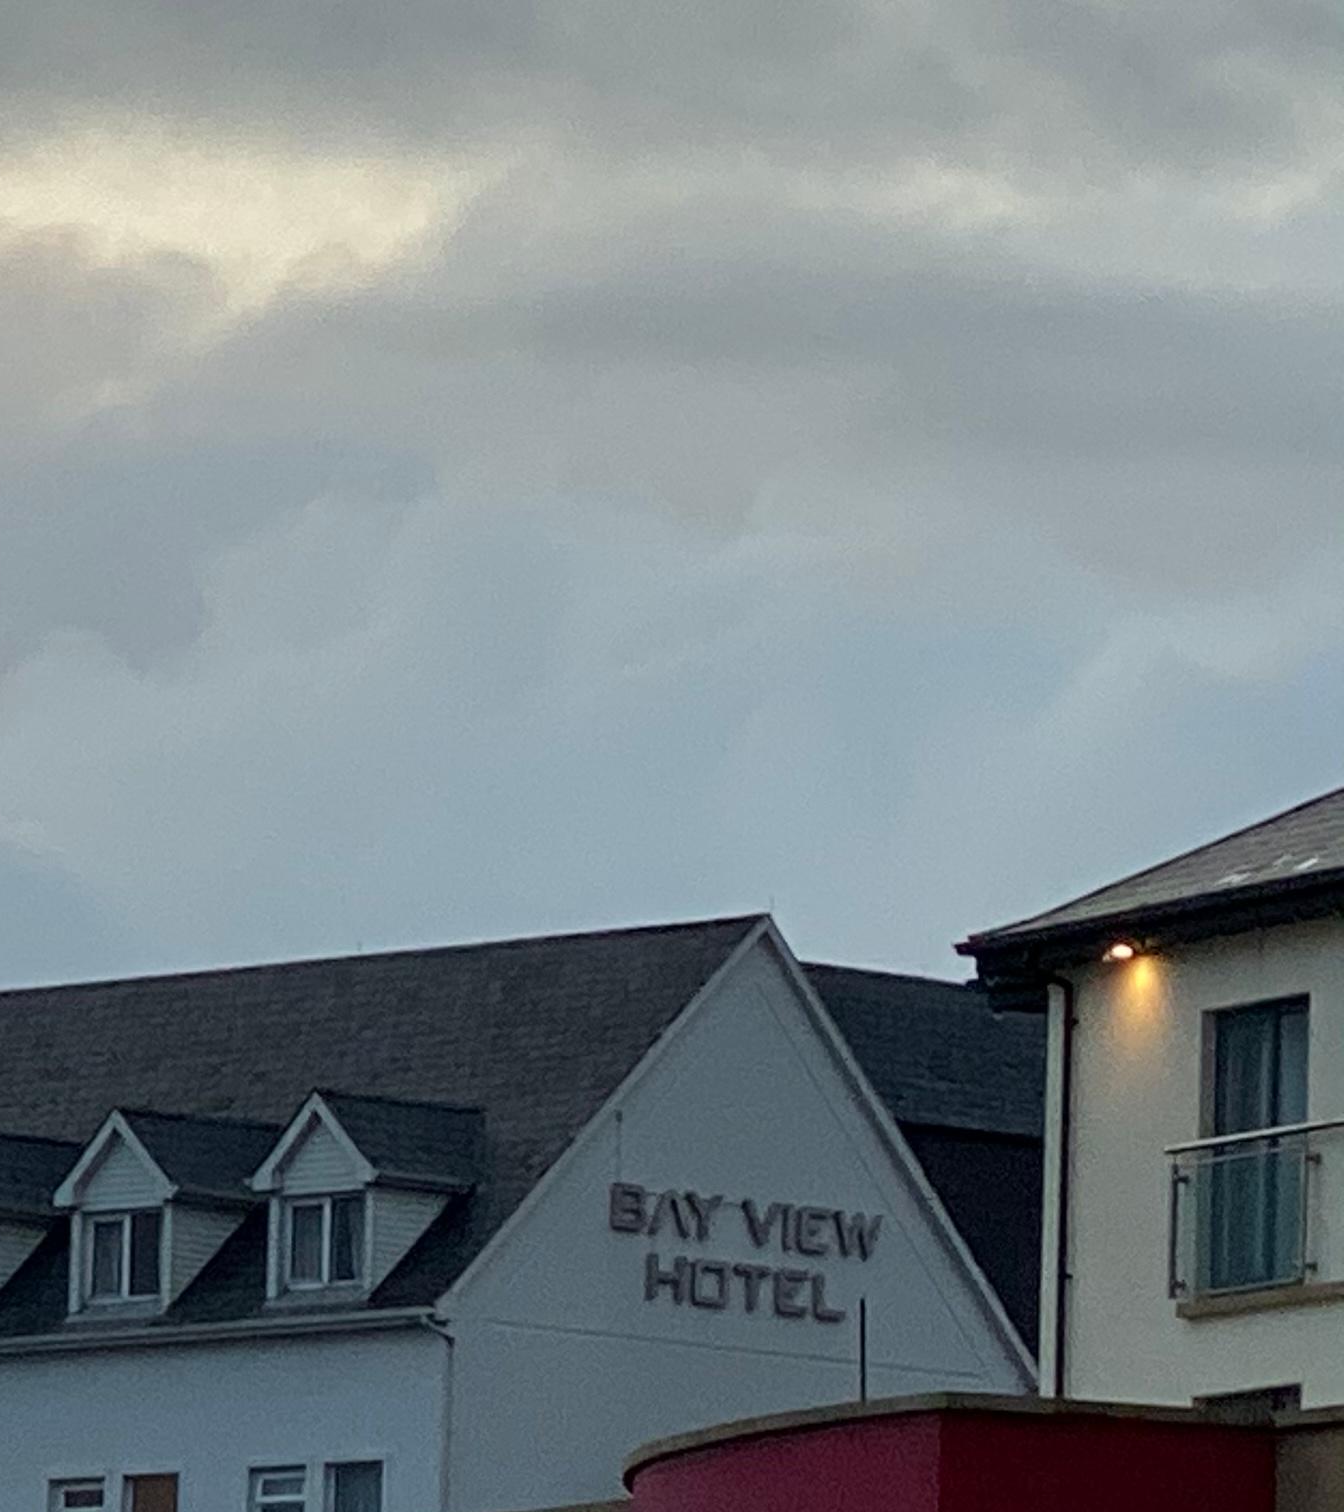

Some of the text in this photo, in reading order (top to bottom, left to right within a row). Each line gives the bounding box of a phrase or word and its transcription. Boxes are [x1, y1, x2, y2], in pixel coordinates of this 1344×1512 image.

[610, 1182, 883, 1262] BAY VIEW
[644, 1253, 847, 1322] HOTEL
